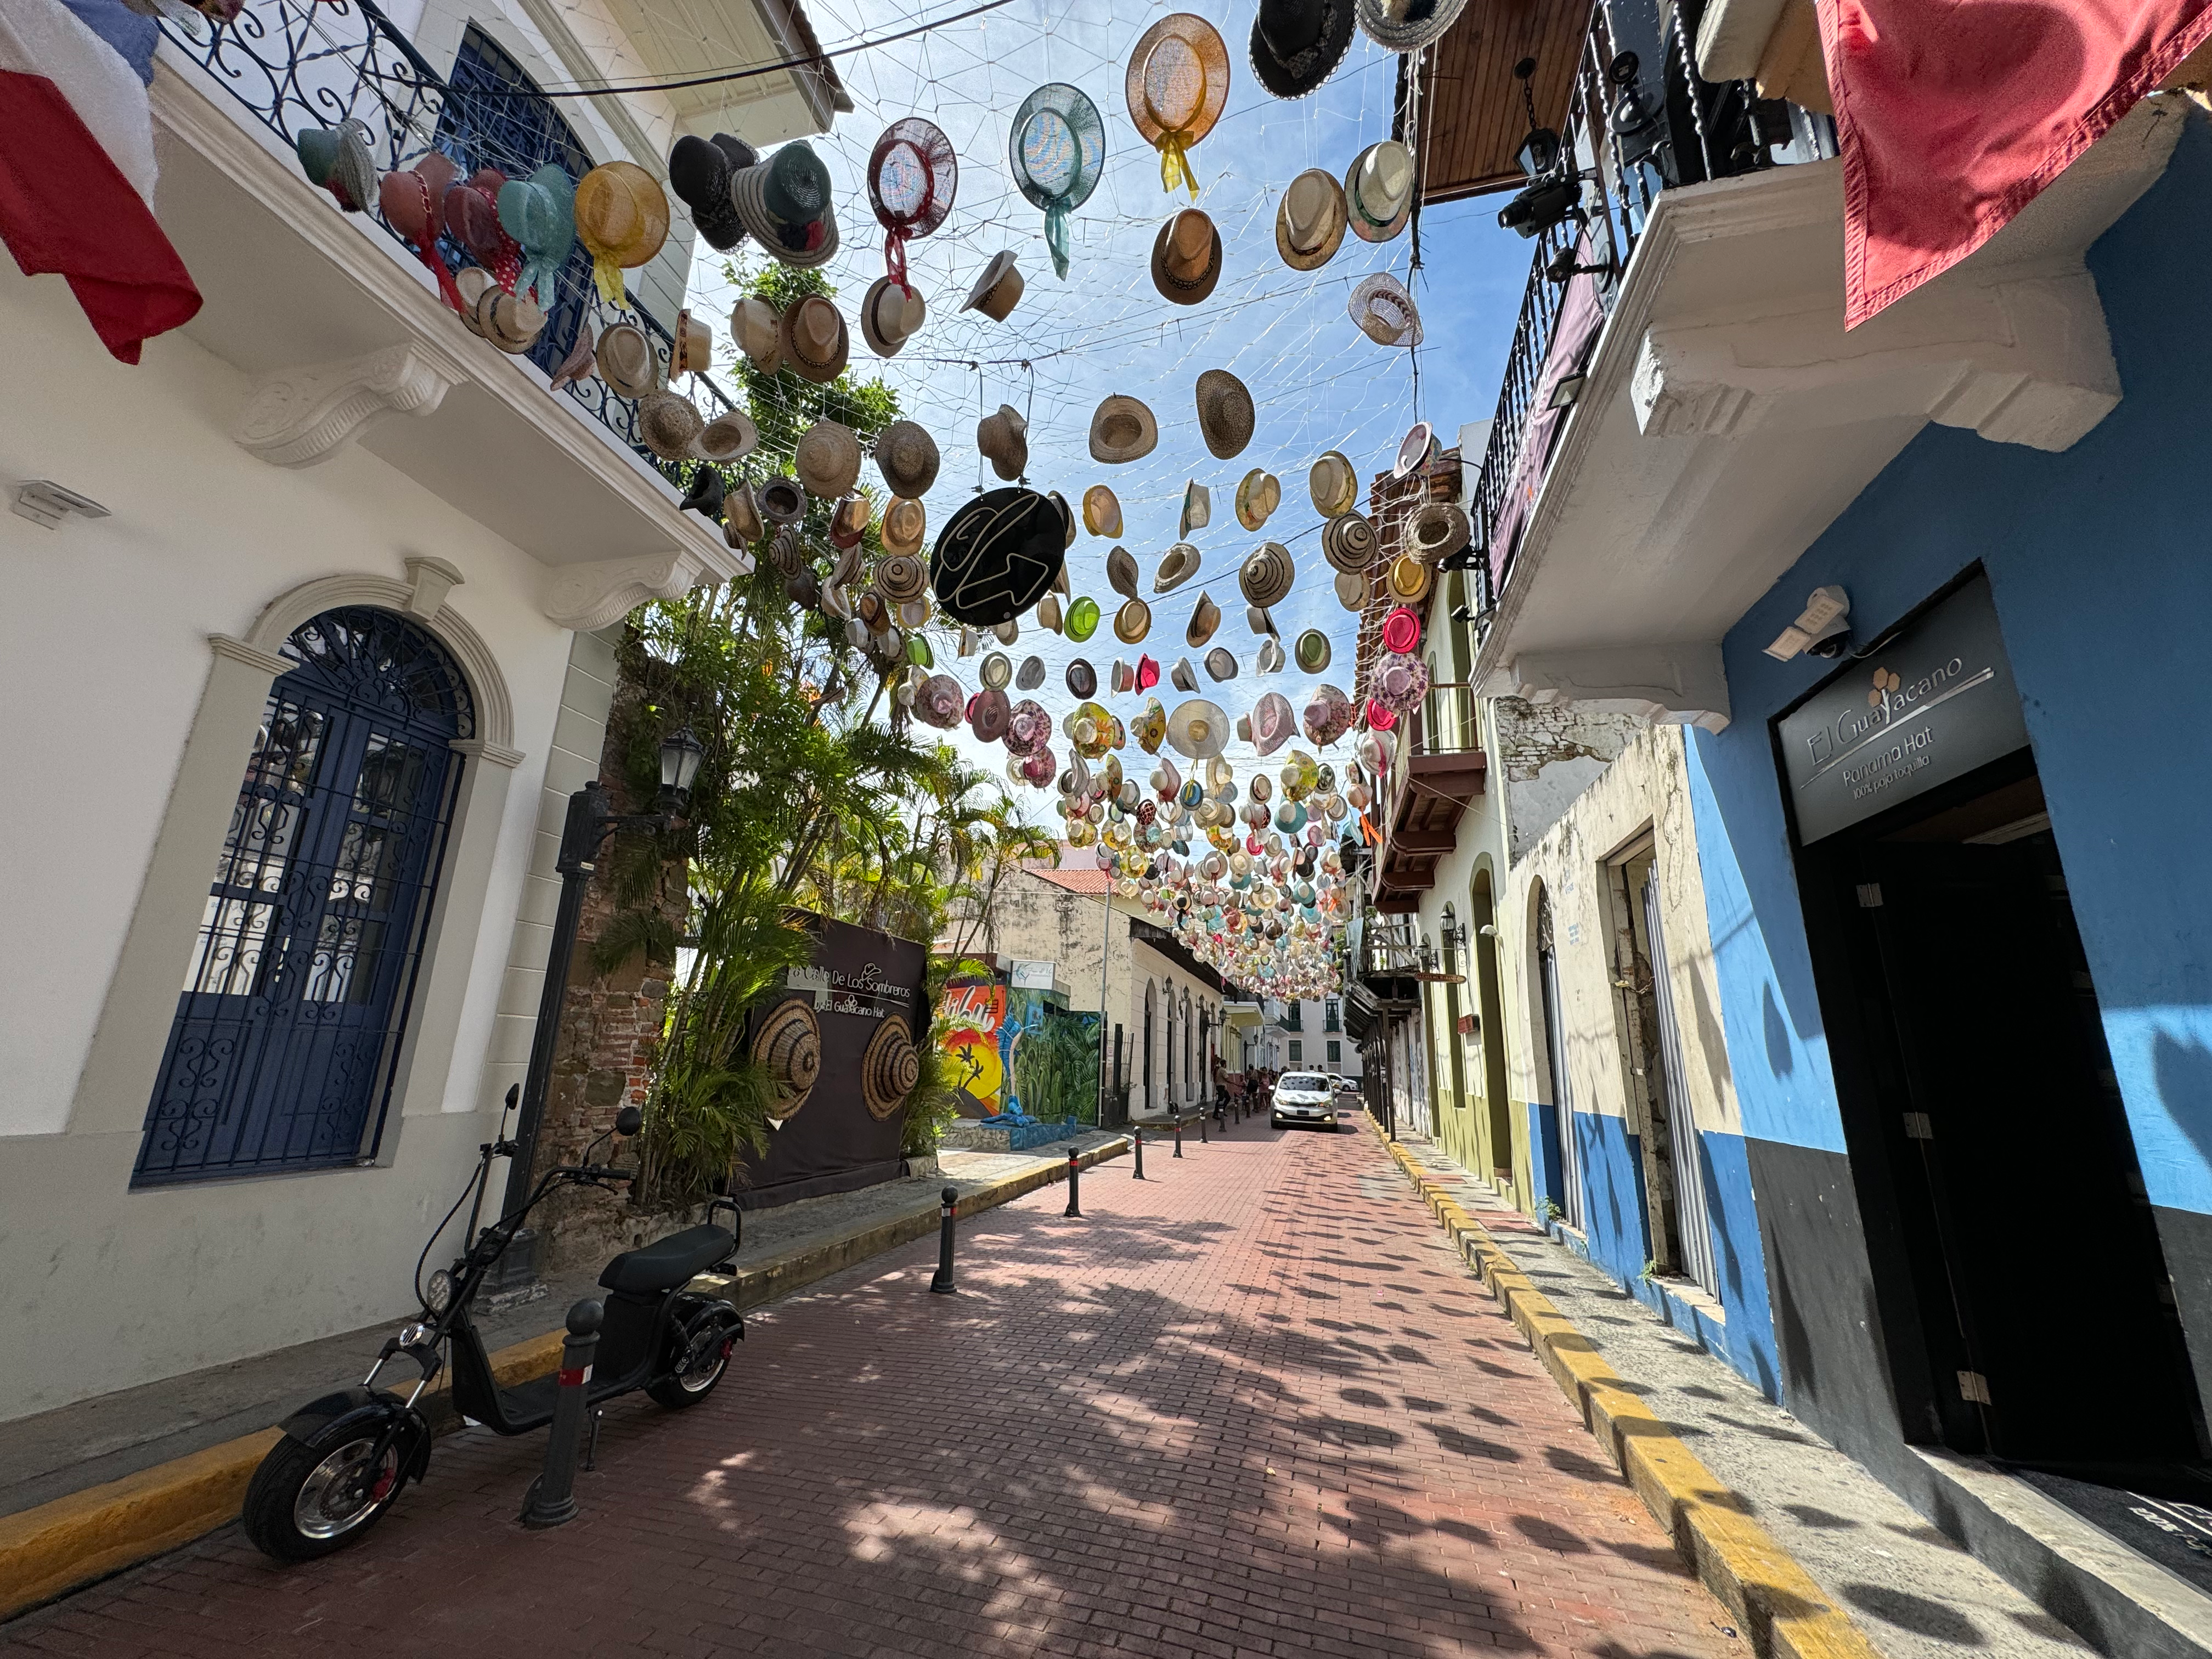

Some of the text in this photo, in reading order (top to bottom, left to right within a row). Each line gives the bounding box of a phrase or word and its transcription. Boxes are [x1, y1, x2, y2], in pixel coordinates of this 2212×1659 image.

[1807, 726, 1833, 766] El
[1843, 726, 1933, 787] Panama Hat
[1853, 755, 1931, 800] 100% paja toquilla
[805, 966, 830, 983] Calle
[832, 970, 845, 986] De
[847, 973, 864, 989] Los
[865, 977, 911, 998] Sombreros
[873, 1006, 885, 1018] Hat
